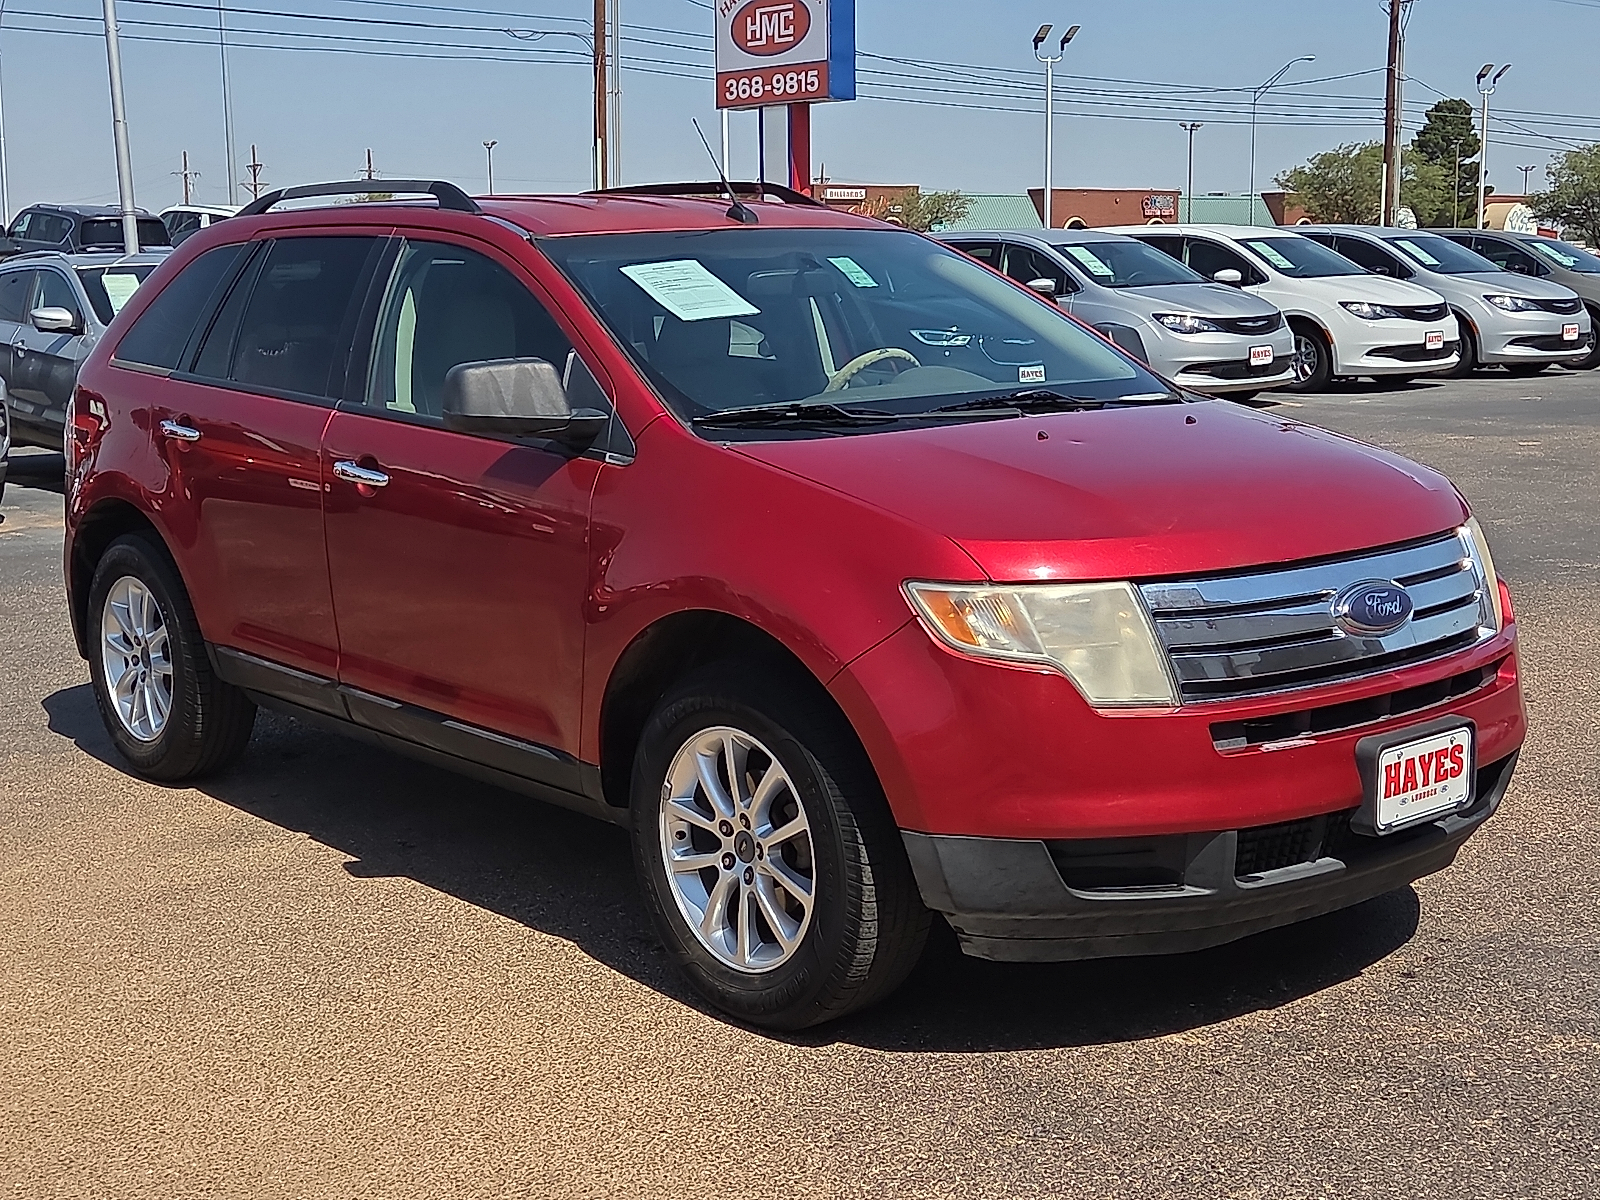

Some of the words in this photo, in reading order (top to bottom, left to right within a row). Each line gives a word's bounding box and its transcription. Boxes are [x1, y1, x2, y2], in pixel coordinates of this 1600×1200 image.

[746, 3, 795, 47] HMC
[724, 69, 819, 101] 368-9815
[829, 190, 864, 198] BILLIARDS
[1252, 349, 1272, 359] HAYES
[1021, 370, 1043, 378] HAYES
[1364, 591, 1403, 620] Ford
[1383, 743, 1464, 799] HAYES
